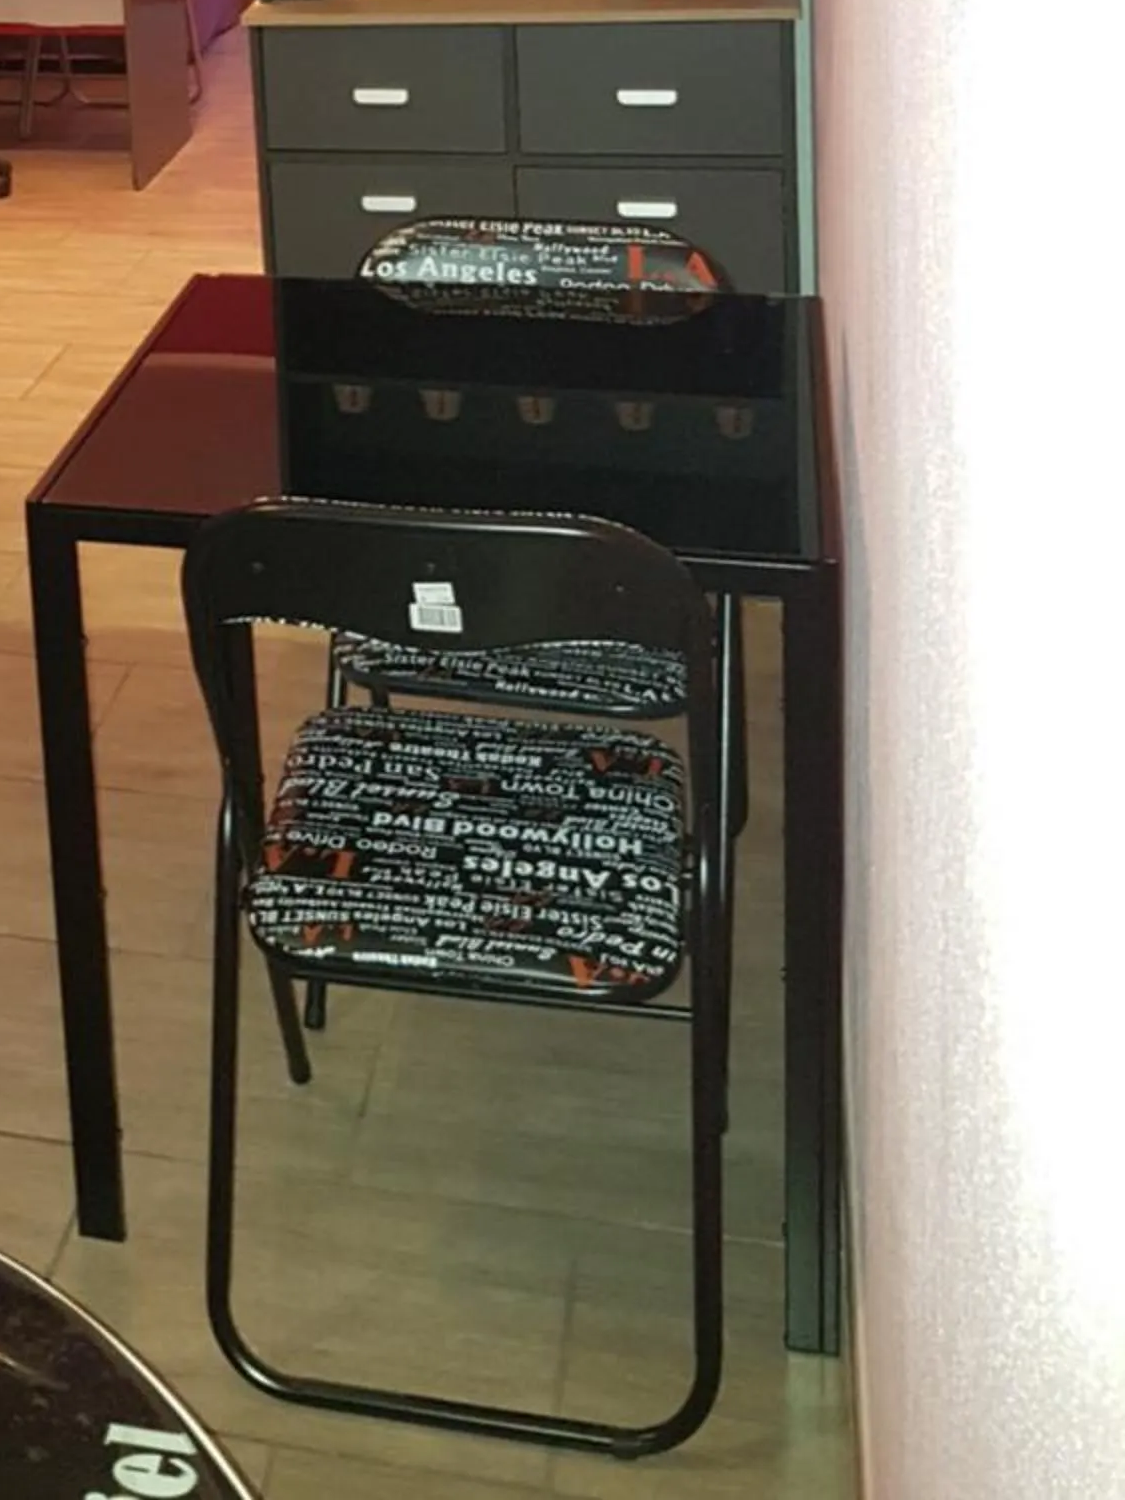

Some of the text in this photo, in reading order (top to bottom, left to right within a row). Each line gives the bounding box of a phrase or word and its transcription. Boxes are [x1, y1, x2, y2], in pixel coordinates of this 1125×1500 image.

[360, 257, 408, 278] Los
[417, 256, 539, 285] Angeles
[286, 754, 440, 781] San Pedro
[501, 779, 580, 800] Town
[589, 786, 675, 813] China
[286, 830, 437, 860] Rodeo Drive
[373, 812, 644, 856] Hollywood Blvd
[462, 855, 680, 906] Los Angeles
[425, 894, 476, 913] Peak
[480, 900, 533, 920] Elsie
[537, 907, 604, 932] Sister
[557, 926, 645, 957] Pedro
